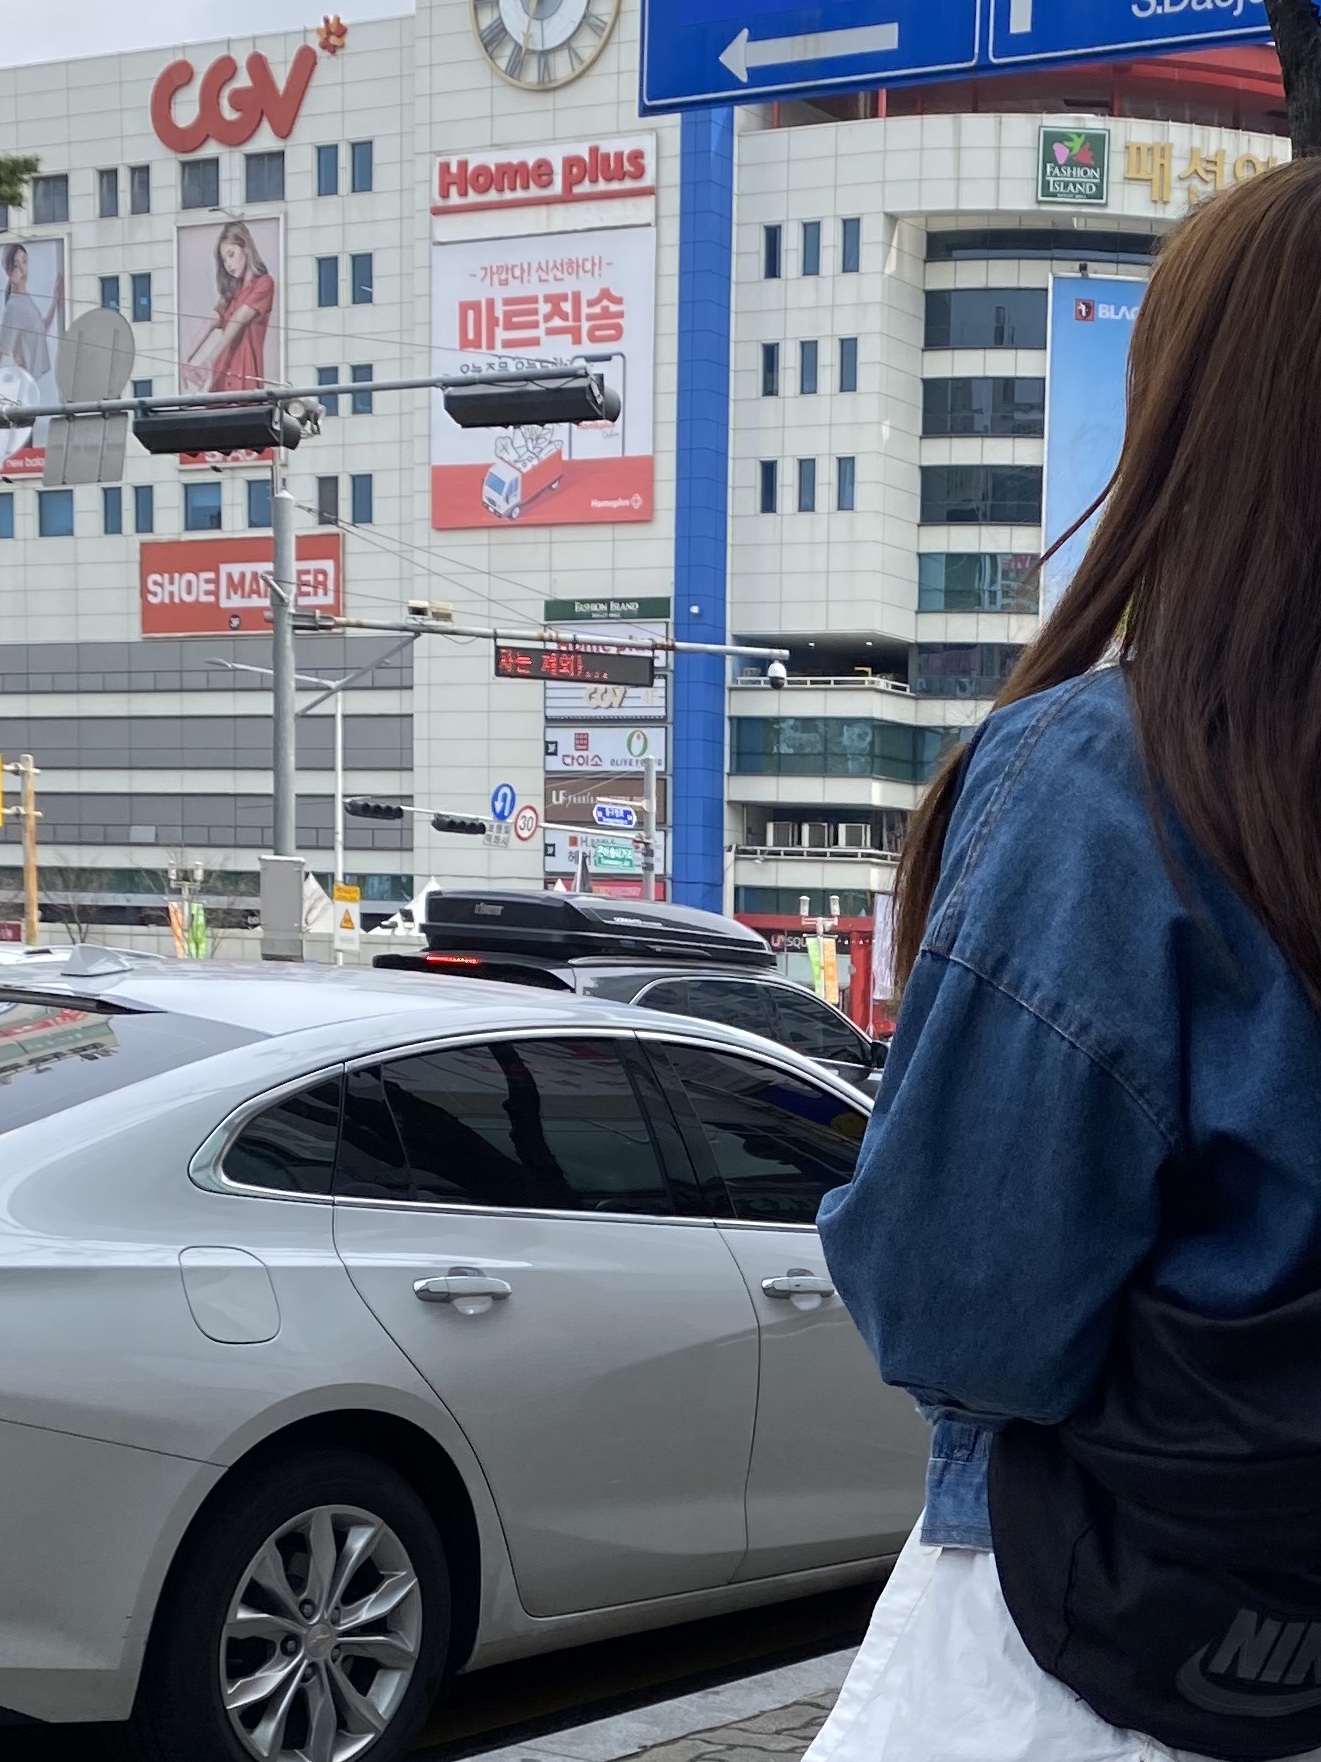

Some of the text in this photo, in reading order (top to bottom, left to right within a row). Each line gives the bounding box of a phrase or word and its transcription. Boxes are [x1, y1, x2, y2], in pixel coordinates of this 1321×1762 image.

[150, 44, 317, 153] CGV
[438, 145, 645, 198] Home plus
[1046, 162, 1100, 179] FASHION
[1049, 178, 1097, 195] ISLAND
[535, 255, 602, 283] 신선하다!
[458, 287, 625, 350] 마트직송
[147, 568, 329, 604] SHOE MAER
[562, 754, 603, 767] 다이소
[518, 814, 534, 832] 30
